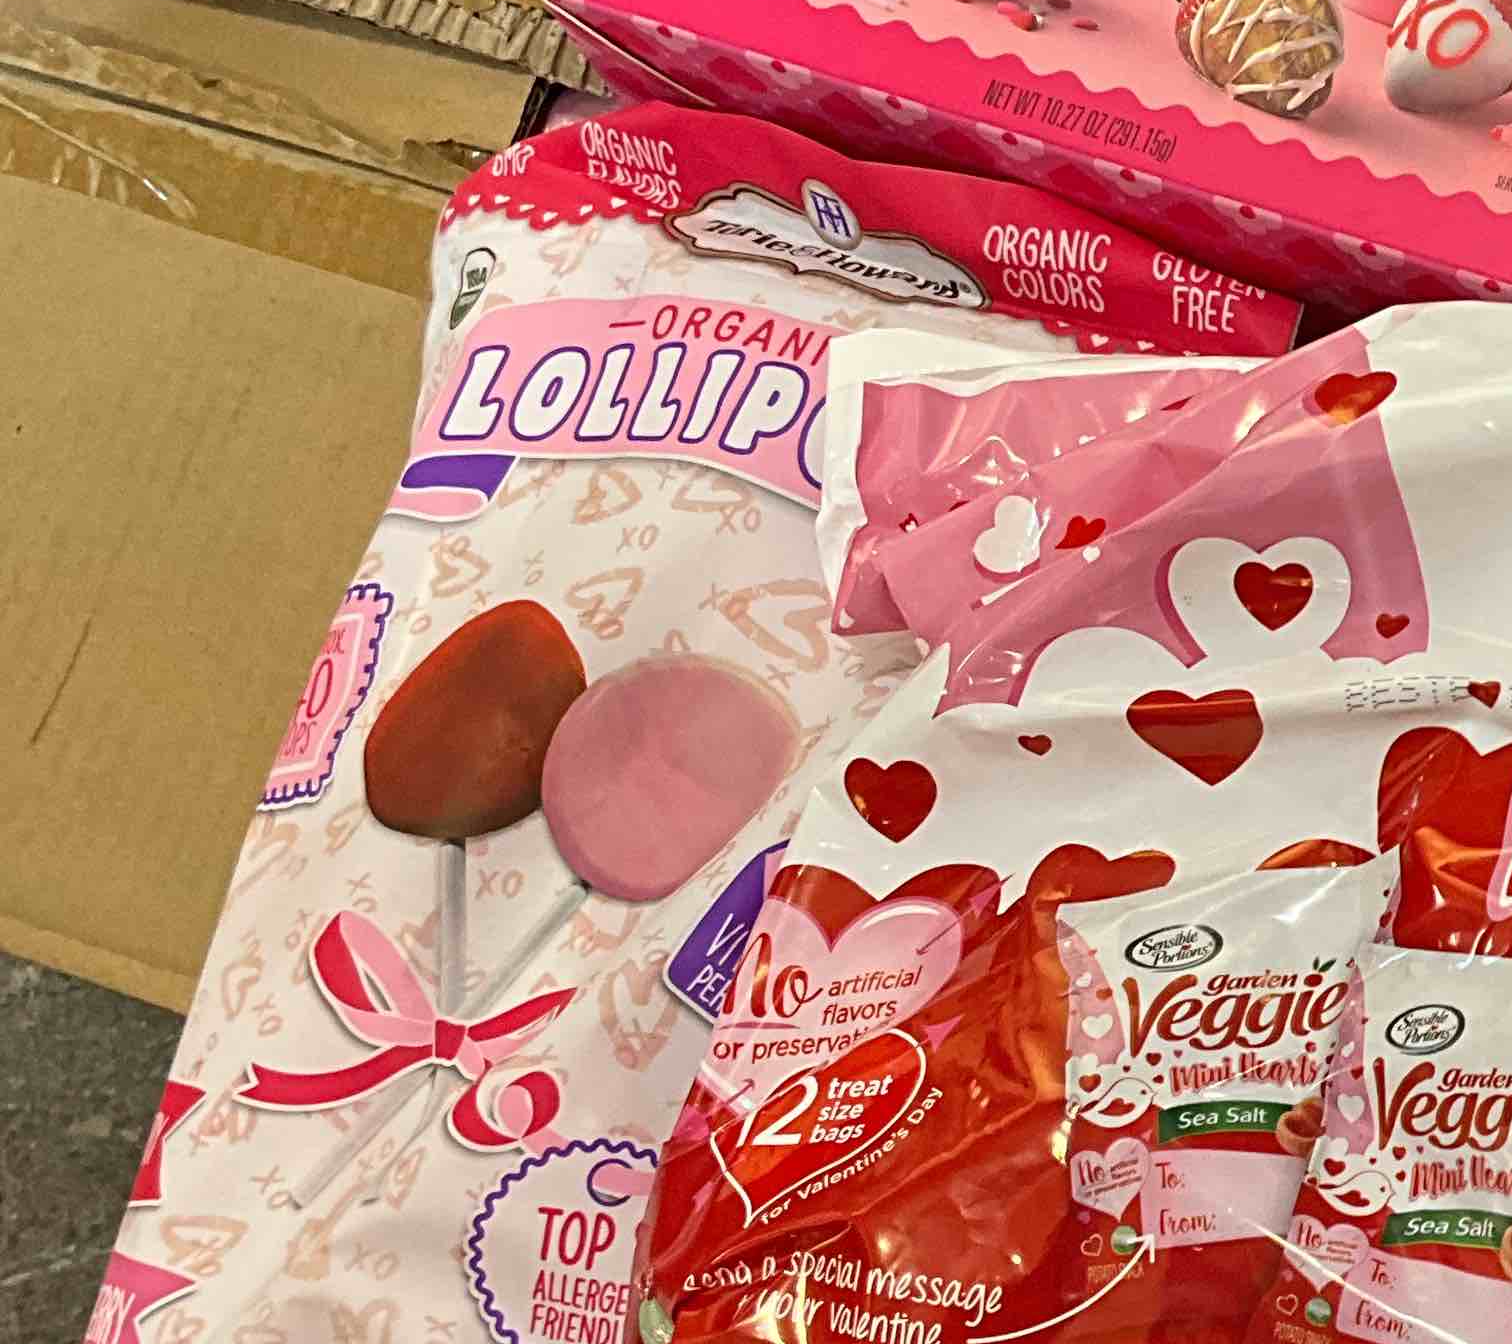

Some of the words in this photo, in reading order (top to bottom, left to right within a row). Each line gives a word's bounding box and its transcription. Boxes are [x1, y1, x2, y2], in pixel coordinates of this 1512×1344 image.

[982, 79, 1018, 113] NET
[1013, 88, 1042, 118] WT
[1041, 96, 1085, 132] 10.27
[1082, 109, 1108, 139] OZ
[579, 121, 677, 176] ORGANIC
[983, 224, 1111, 272] ORGANIC
[1003, 268, 1105, 312] COLORS
[1173, 285, 1241, 333] FREE
[651, 303, 830, 367] ORGANI
[440, 341, 823, 488] LOLLIP
[1139, 928, 1198, 955] Sensible
[1152, 945, 1210, 967] Portions
[722, 932, 823, 1019] No
[827, 966, 923, 998] artificial
[1202, 970, 1297, 996] garden
[821, 998, 898, 1027] flavors
[1122, 974, 1349, 1058] Veggie
[1398, 1010, 1448, 1032] Sensible
[713, 1039, 744, 1061] or
[751, 1028, 868, 1064] preservat
[1403, 1027, 1451, 1047] Portions
[826, 1075, 893, 1100] treat
[1170, 1056, 1236, 1096] Mini
[1239, 1051, 1319, 1088] Hearts
[818, 1101, 865, 1122] size
[1178, 1112, 1218, 1128] Sea
[1226, 1107, 1267, 1124] Salt
[809, 1120, 866, 1145] bags
[760, 1197, 793, 1226] for
[796, 1126, 909, 1200] Valentine's
[911, 1085, 945, 1126] Day
[1078, 1160, 1106, 1185] No
[1155, 1161, 1185, 1189] To:
[1410, 1157, 1467, 1201] Mini
[537, 1206, 616, 1271] TOP
[1159, 1209, 1216, 1236] From:
[1299, 1223, 1323, 1248] No
[1404, 1217, 1448, 1236] Sea
[1455, 1217, 1495, 1238] Salt
[782, 1250, 860, 1294] special
[865, 1267, 1003, 1328] message
[1370, 1258, 1396, 1288] To:
[532, 1269, 631, 1316] ALLERGE
[1356, 1300, 1412, 1340] From:
